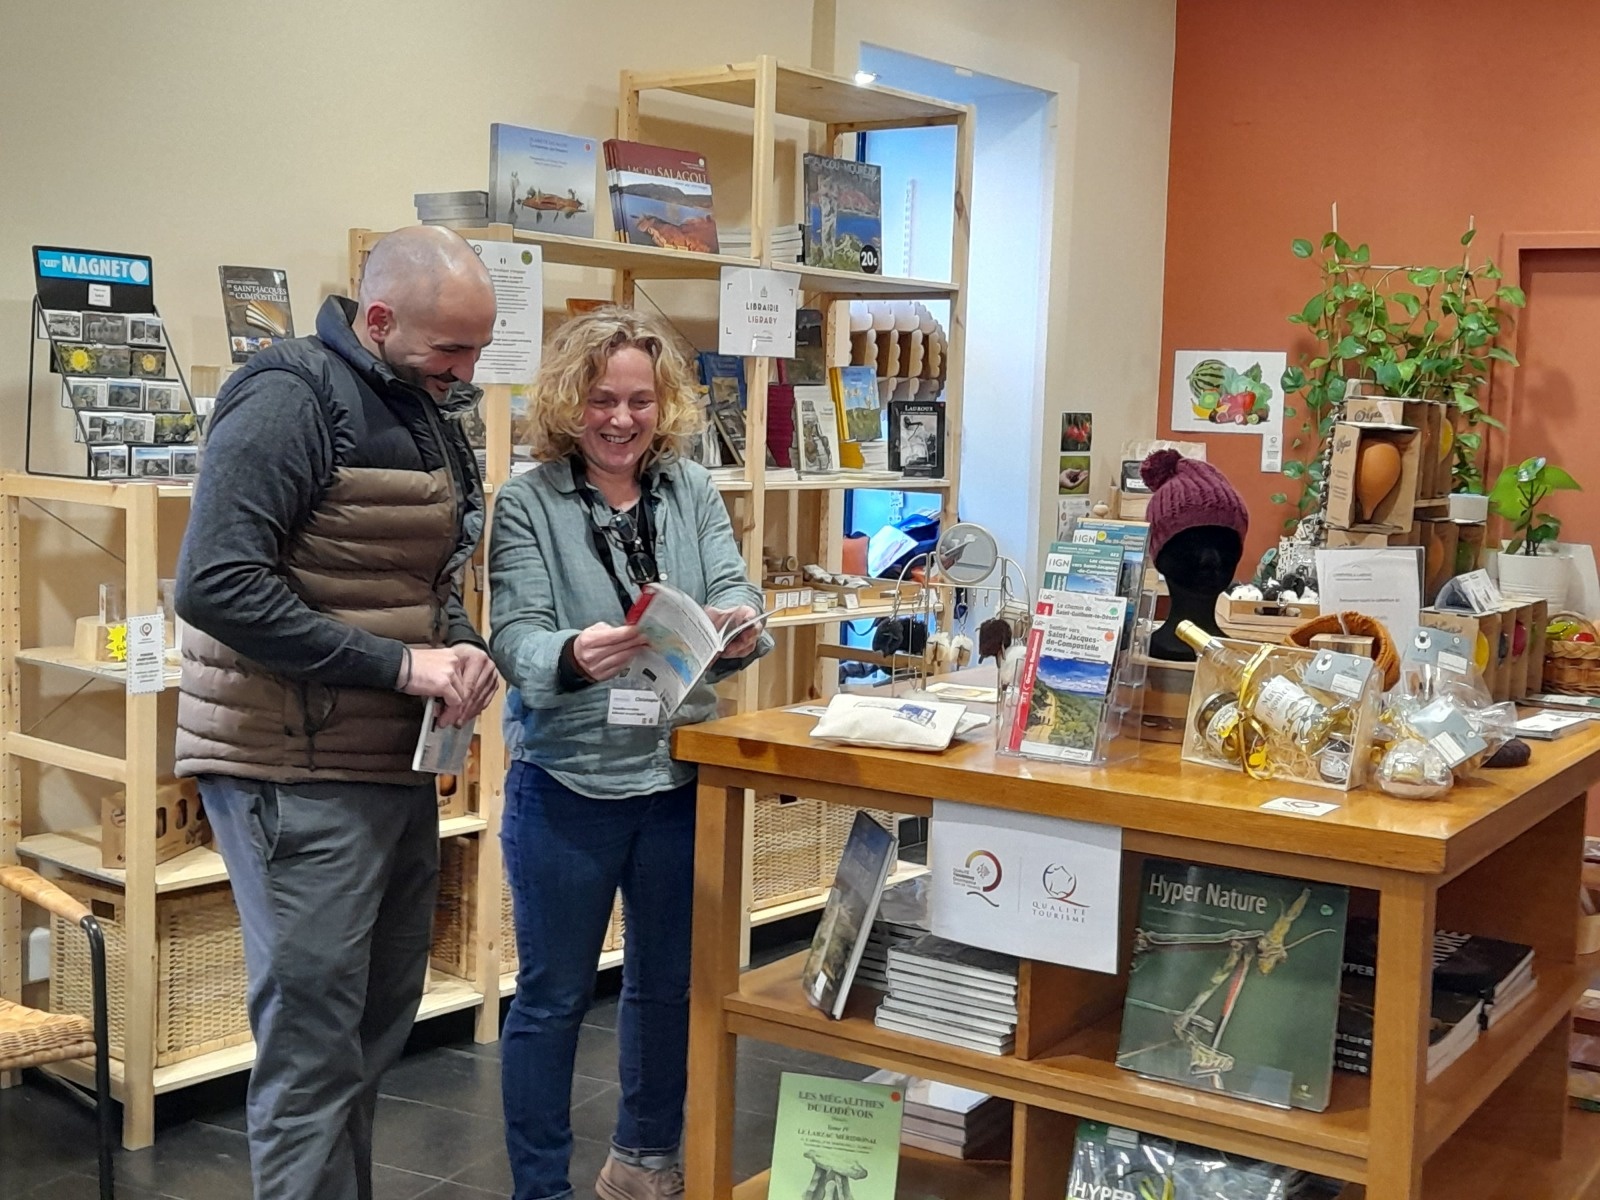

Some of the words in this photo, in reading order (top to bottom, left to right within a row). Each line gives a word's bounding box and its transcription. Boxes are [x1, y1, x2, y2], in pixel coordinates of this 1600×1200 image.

[657, 166, 707, 184] SALAGOU
[860, 250, 878, 267] 20€
[745, 301, 779, 312] LIBRAIRIE
[747, 315, 778, 325] LIBRARY
[1048, 630, 1100, 643] Saint-Jacques-
[1046, 639, 1100, 652] de-Compostelle
[1149, 873, 1203, 905] Hyper
[1205, 882, 1268, 915] Nature
[1032, 909, 1086, 924] TOURISME
[798, 1091, 817, 1100] LES
[807, 1103, 820, 1112] DU
[823, 1105, 873, 1119] LODÉVOIS
